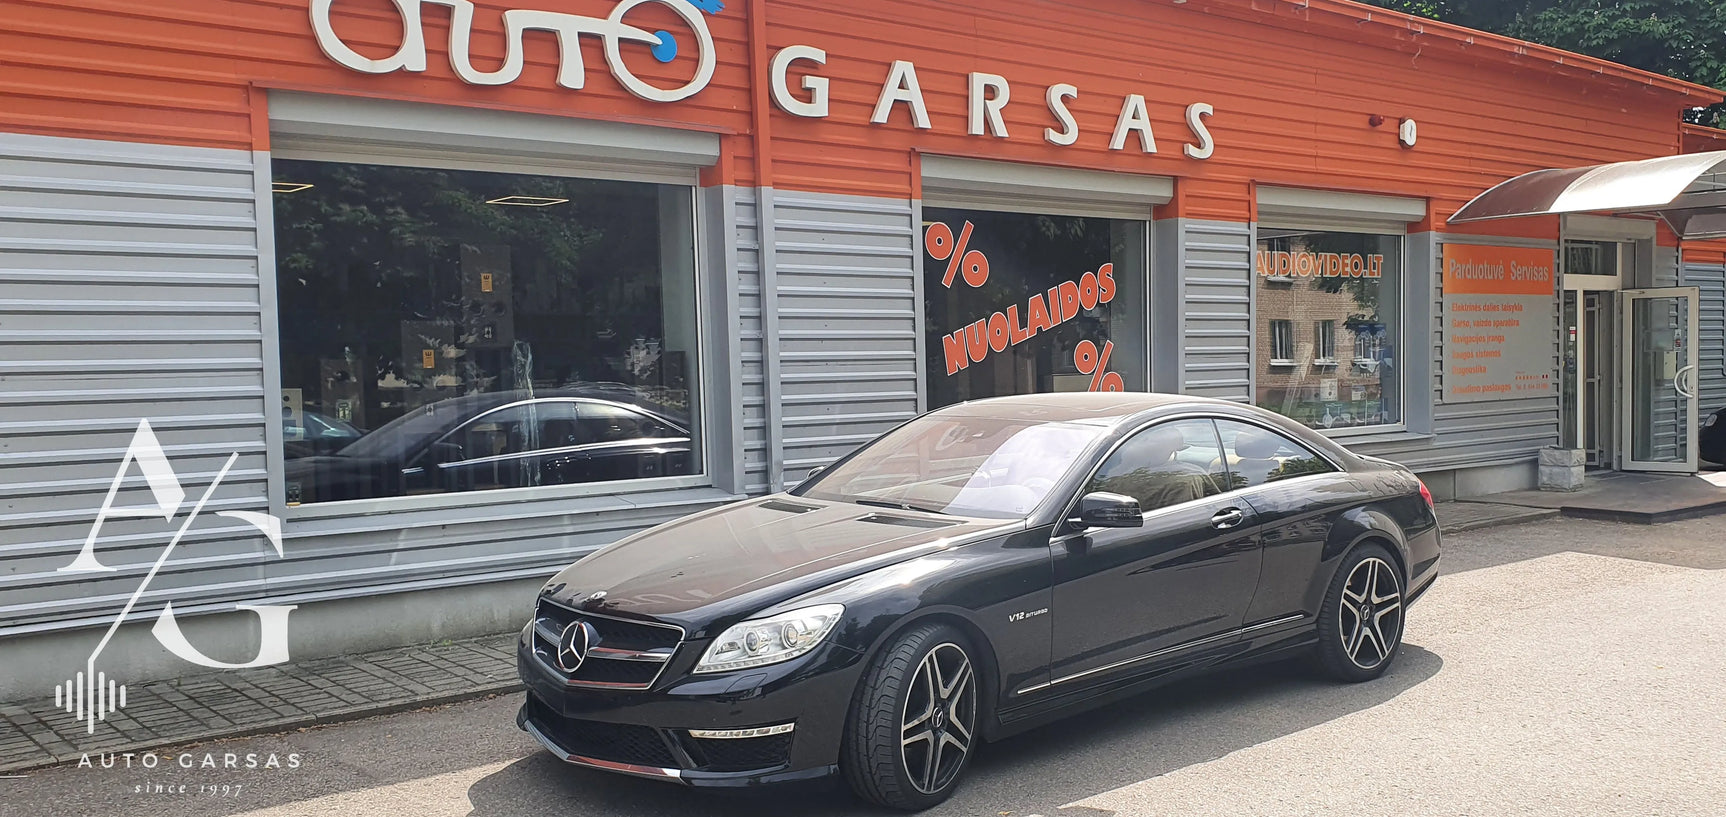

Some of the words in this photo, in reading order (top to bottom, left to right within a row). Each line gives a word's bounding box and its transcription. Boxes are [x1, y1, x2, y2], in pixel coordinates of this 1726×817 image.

[768, 45, 1215, 160] GARSAS
[1256, 251, 1384, 278] AUDIOVIDEO.LT
[1449, 258, 1505, 280] Parduotuvė
[1510, 260, 1550, 281] Servisas
[942, 263, 1116, 376] NUOLAIDOS
[1009, 611, 1025, 623] V12
